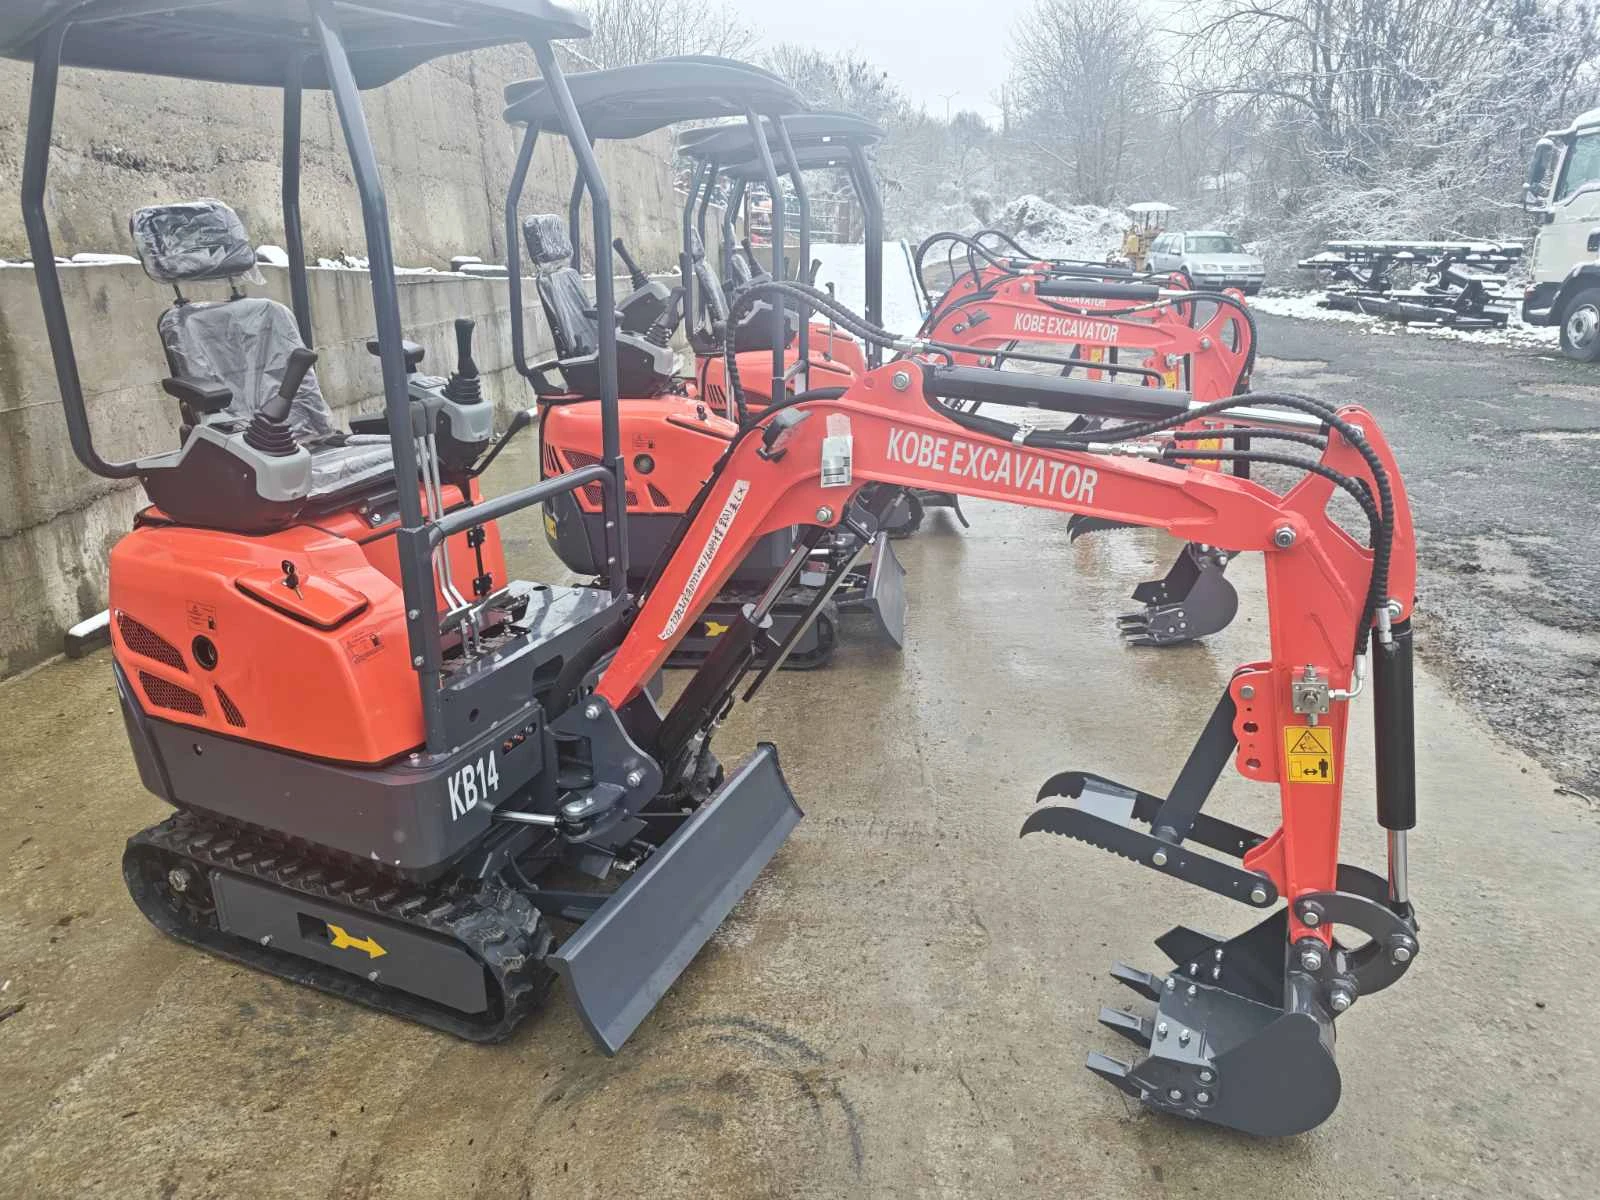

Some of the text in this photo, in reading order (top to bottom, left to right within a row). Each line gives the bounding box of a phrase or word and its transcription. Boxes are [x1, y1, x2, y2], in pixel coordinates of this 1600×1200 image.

[1014, 312, 1119, 342] KOBE EXCAVATOR
[886, 427, 949, 471] KOBE
[949, 440, 1098, 504] EXCAVATOR
[448, 750, 499, 822] KB14
